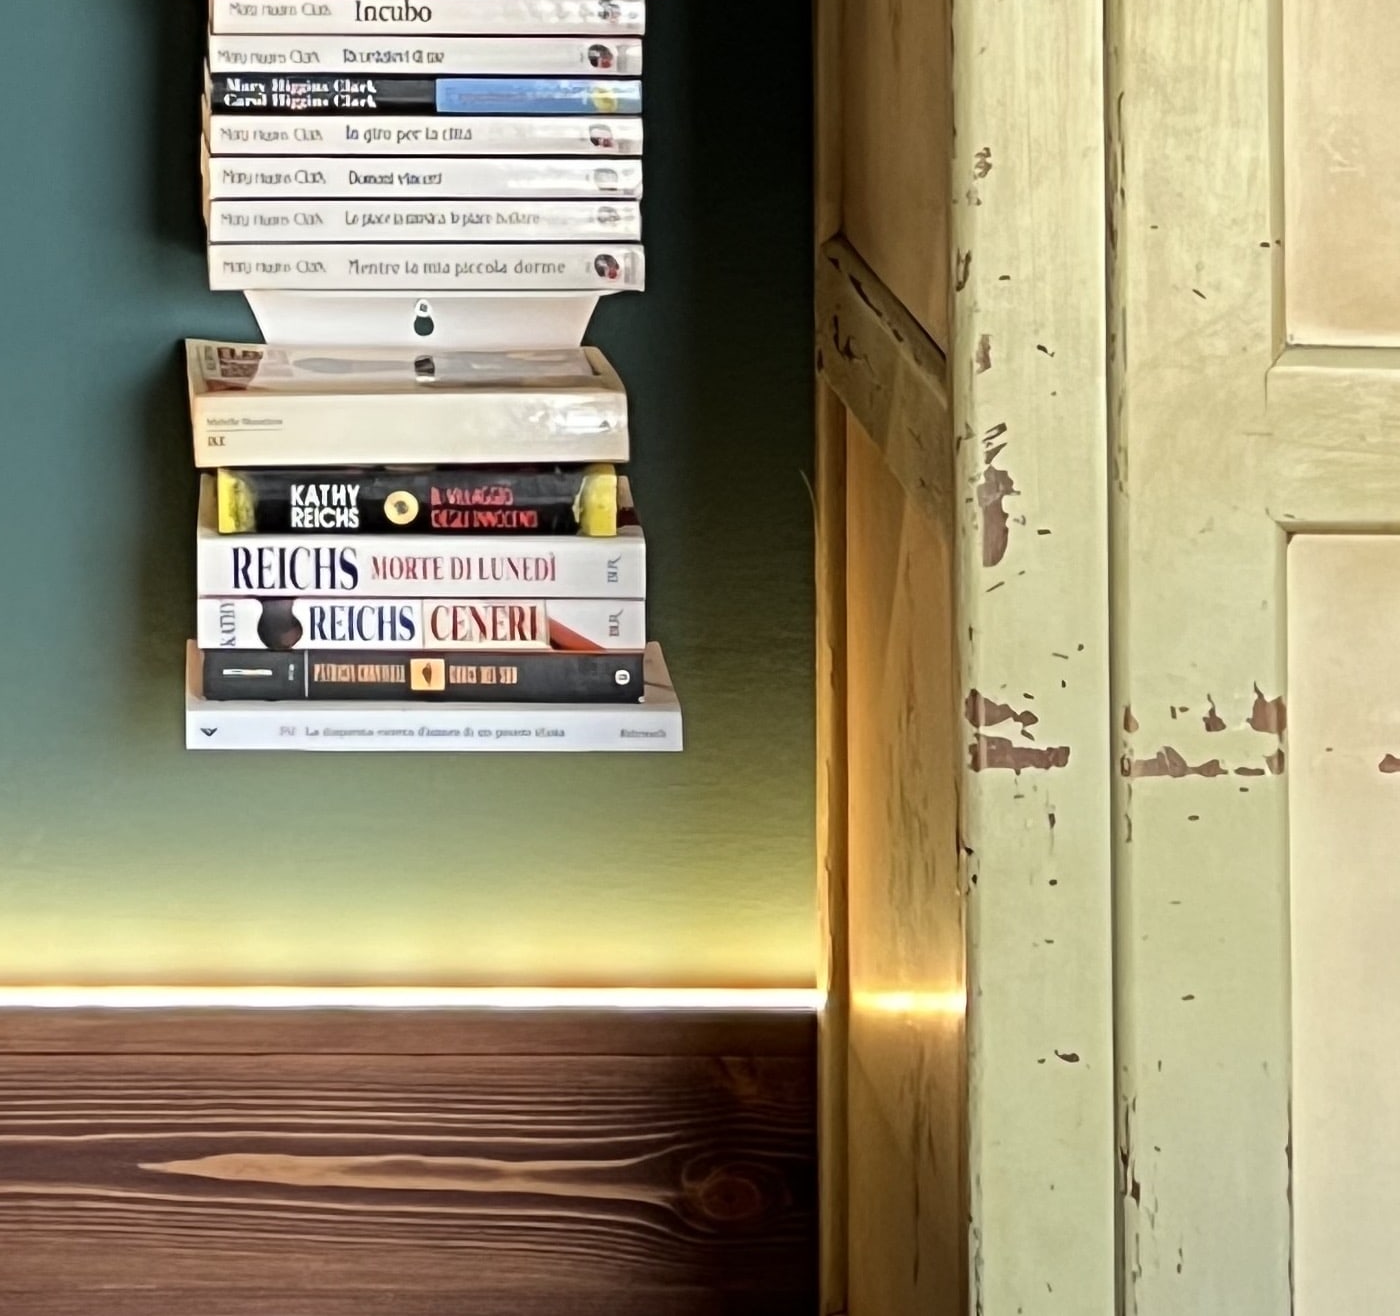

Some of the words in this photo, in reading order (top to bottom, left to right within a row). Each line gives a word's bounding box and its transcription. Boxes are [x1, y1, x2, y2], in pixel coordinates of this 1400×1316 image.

[355, 0, 432, 23] Incubo
[226, 78, 265, 92] Mary
[271, 78, 329, 94] Higgins
[333, 79, 377, 92] Clark
[224, 94, 267, 107] Carol
[271, 94, 329, 109] Higgins
[333, 94, 377, 108] Clark
[363, 128, 391, 143] giro
[396, 129, 421, 143] per
[348, 259, 400, 275] Mentre
[404, 261, 419, 274] la
[423, 262, 450, 274] mia
[455, 260, 508, 277] piccola
[514, 260, 566, 274] dorme
[290, 484, 360, 506] KATHY
[290, 507, 360, 528] REICHS
[232, 546, 359, 590] REICHS
[371, 555, 443, 581] MORTE
[451, 555, 471, 581] DI
[479, 551, 556, 582] LUNEDÌ
[309, 604, 416, 641] REICHS
[430, 604, 538, 642] CENERI
[305, 726, 319, 737] La
